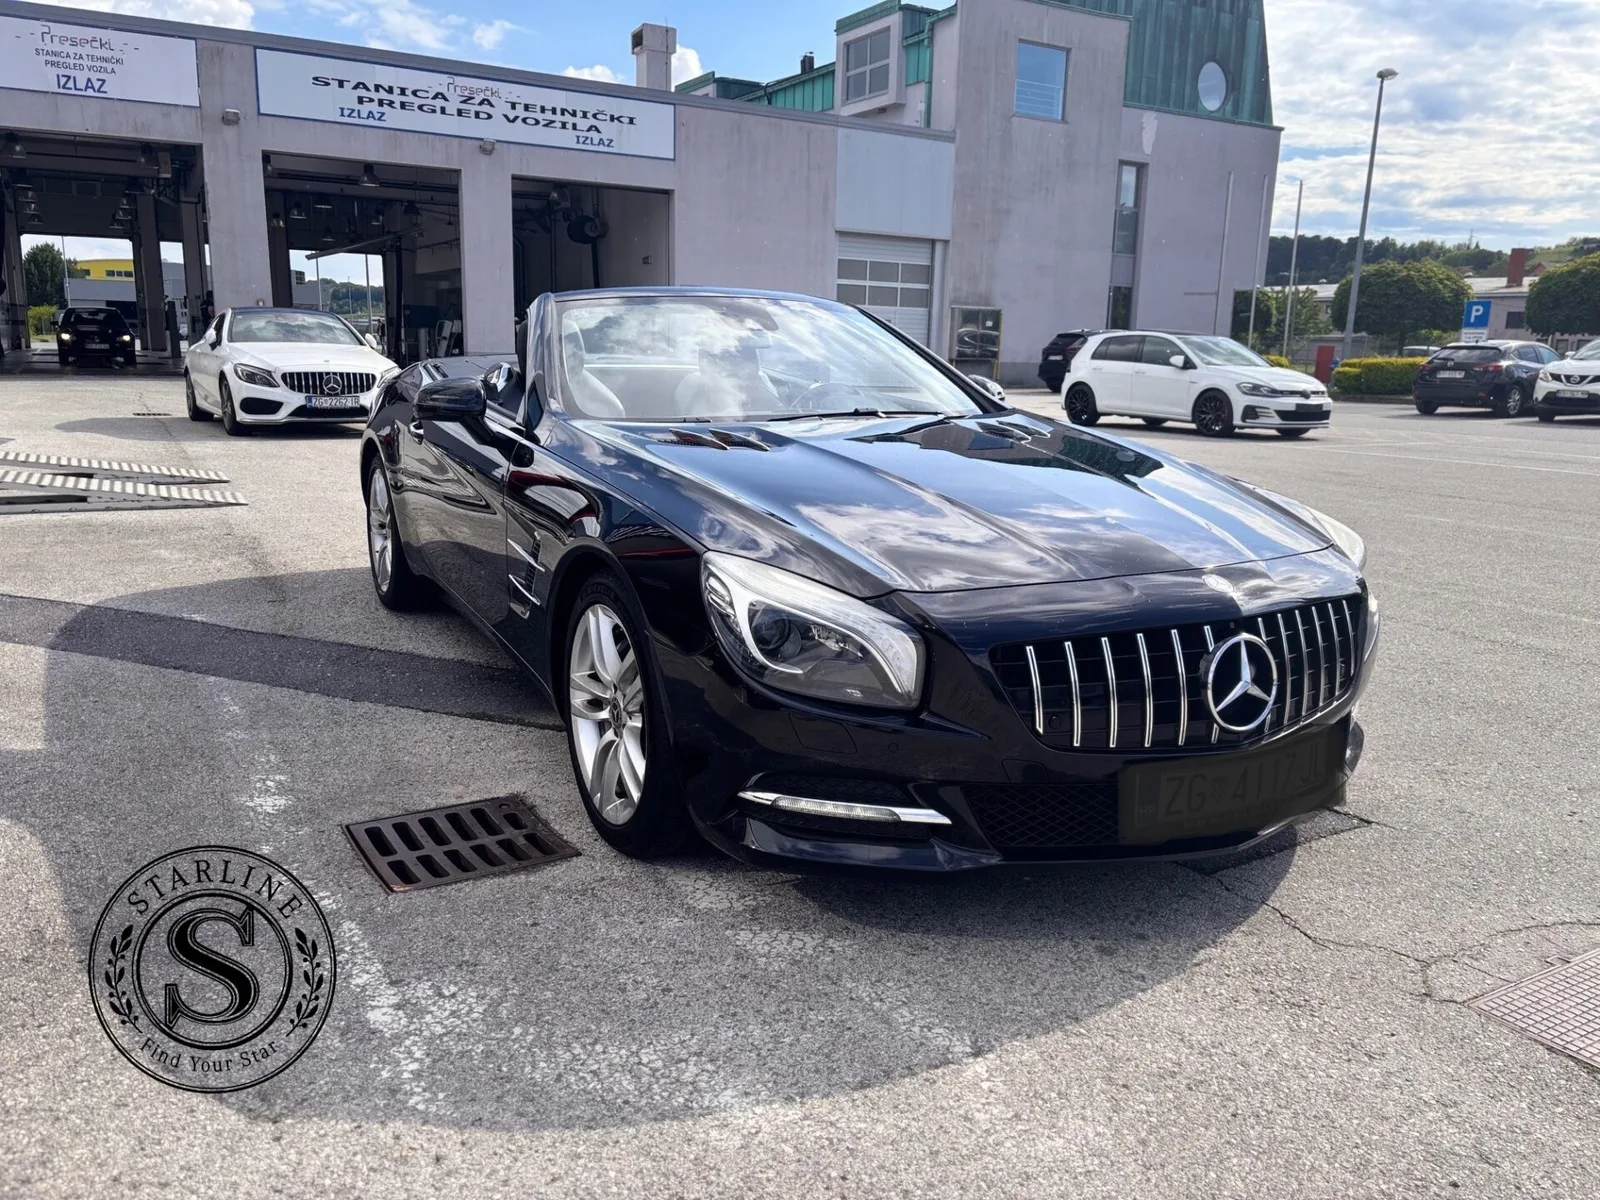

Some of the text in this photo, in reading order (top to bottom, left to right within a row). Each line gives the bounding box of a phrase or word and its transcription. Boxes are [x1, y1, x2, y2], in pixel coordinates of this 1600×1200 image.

[40, 24, 114, 52] Presečki
[34, 48, 124, 66] STANICA ZA TEHNIČKI
[44, 59, 116, 75] PREGLED VOZILA
[56, 73, 108, 94] IZLAZ
[446, 75, 501, 99] Presečki
[311, 76, 637, 126] STANICA ZA TEHNIČKI
[338, 106, 387, 122] IZLAZ
[357, 95, 603, 134] PREGLED VOZILA
[574, 134, 615, 149] IZLAZ
[1470, 305, 1484, 323] P
[1165, 774, 1207, 816] ZG
